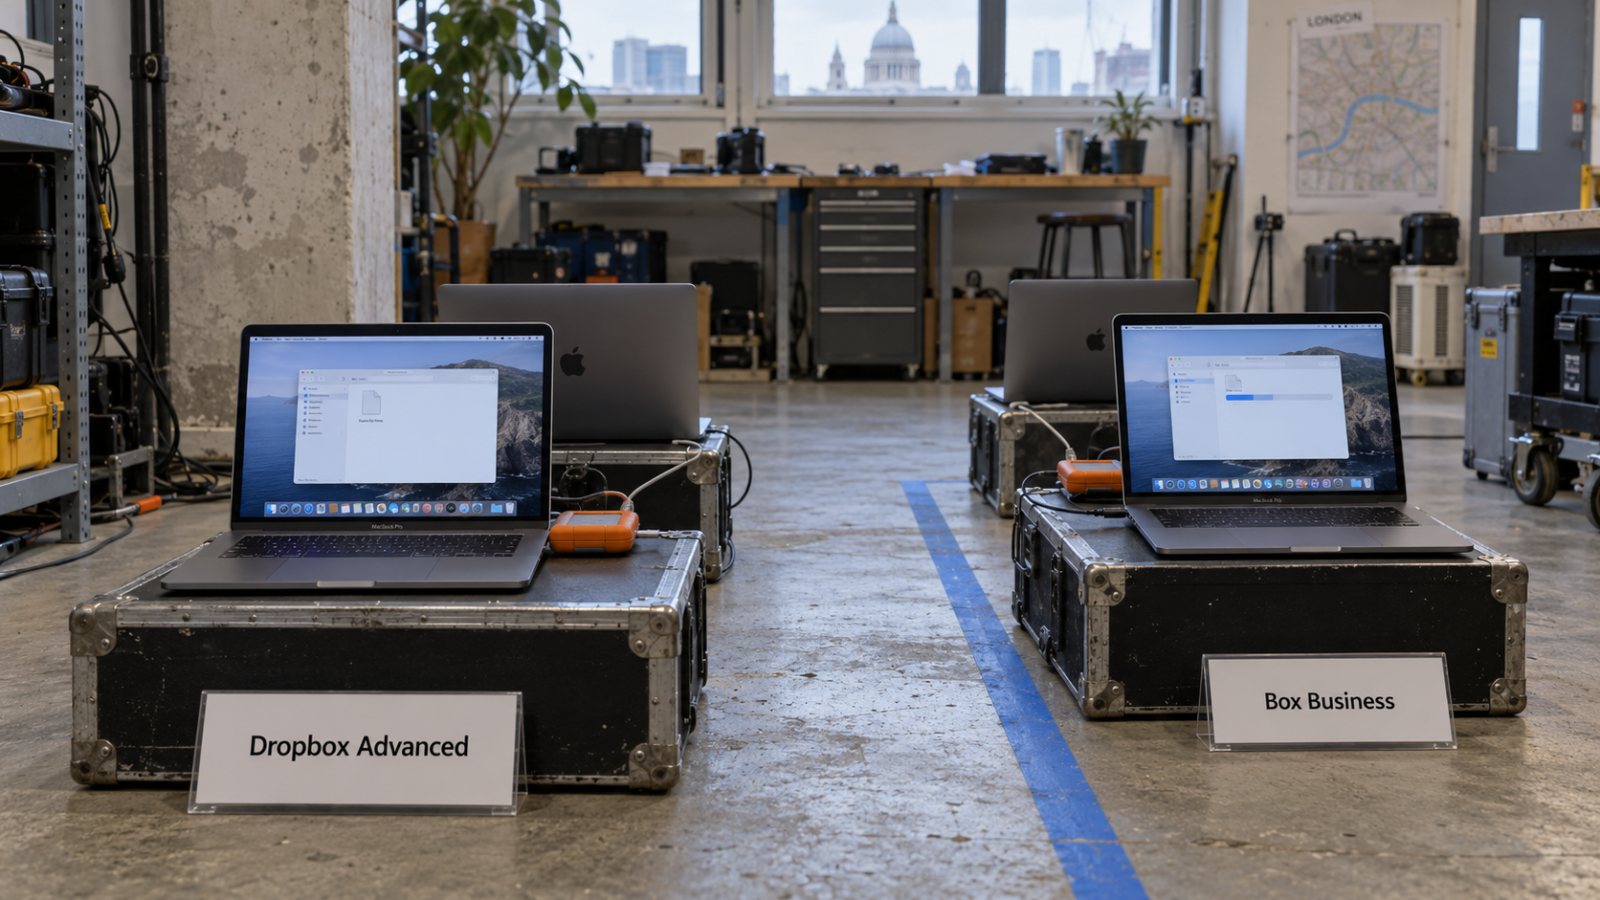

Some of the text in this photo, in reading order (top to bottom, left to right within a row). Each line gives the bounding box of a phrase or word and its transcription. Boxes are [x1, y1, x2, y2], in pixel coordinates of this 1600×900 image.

[1307, 11, 1362, 27] LONDON
[1265, 691, 1395, 711] Box Business
[250, 734, 468, 762] Dropbox Advanced
